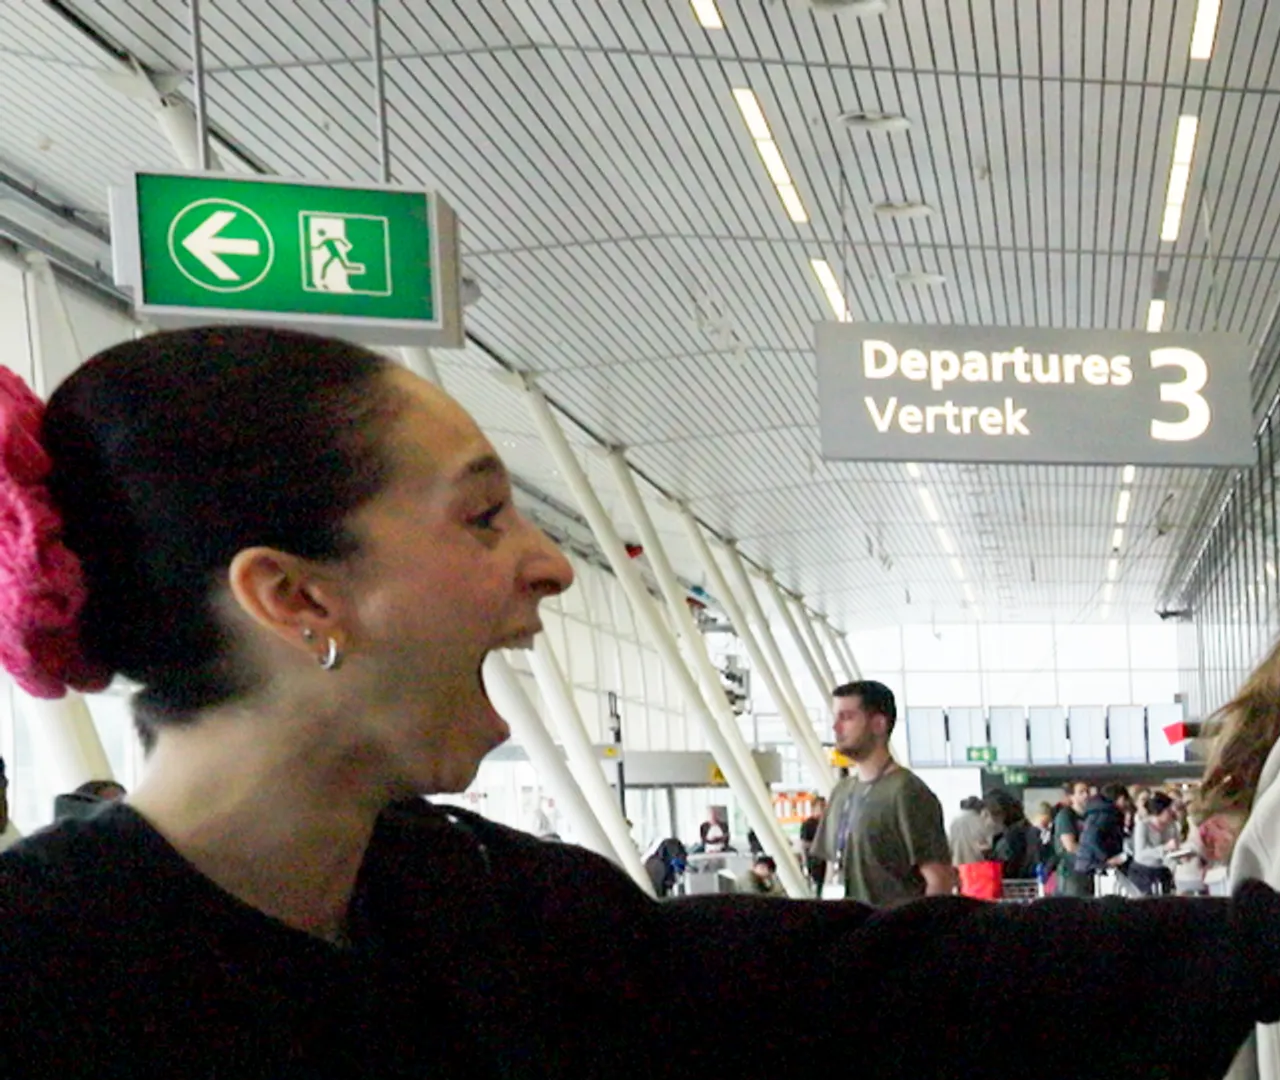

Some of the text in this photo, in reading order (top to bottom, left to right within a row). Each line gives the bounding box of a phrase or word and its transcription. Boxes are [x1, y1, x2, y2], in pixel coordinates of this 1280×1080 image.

[862, 340, 1211, 441] Departures 3
[865, 397, 1030, 435] Vertrek
